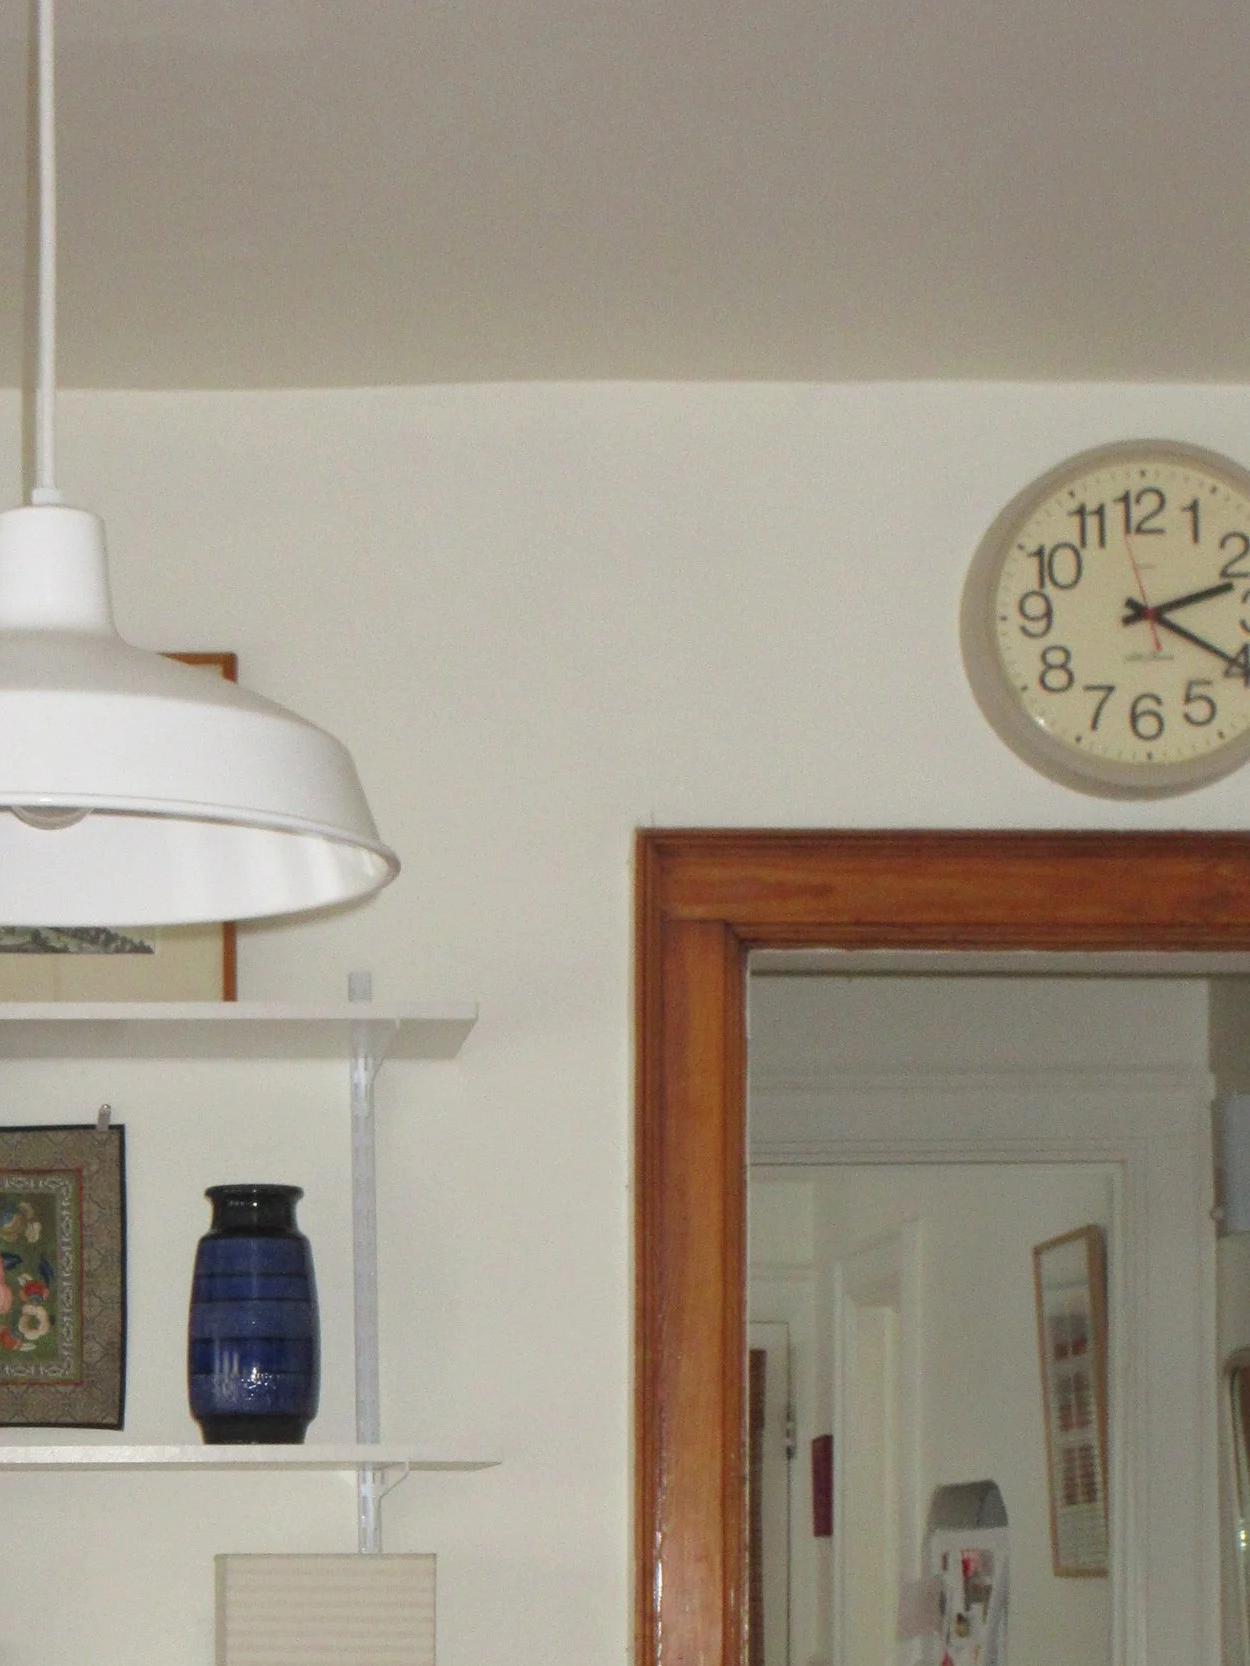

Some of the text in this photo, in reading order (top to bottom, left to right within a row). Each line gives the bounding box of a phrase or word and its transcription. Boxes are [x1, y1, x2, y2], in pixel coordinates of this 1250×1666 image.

[1067, 501, 1107, 549] 11
[1114, 486, 1166, 536] 12
[1180, 496, 1201, 545] 1
[1026, 540, 1084, 591] 10
[1218, 531, 1250, 579] 2
[1018, 590, 1054, 639] 9
[1038, 645, 1075, 693] 8
[1082, 684, 1116, 732] 7
[1129, 692, 1165, 742] 6
[1182, 679, 1217, 727] 5
